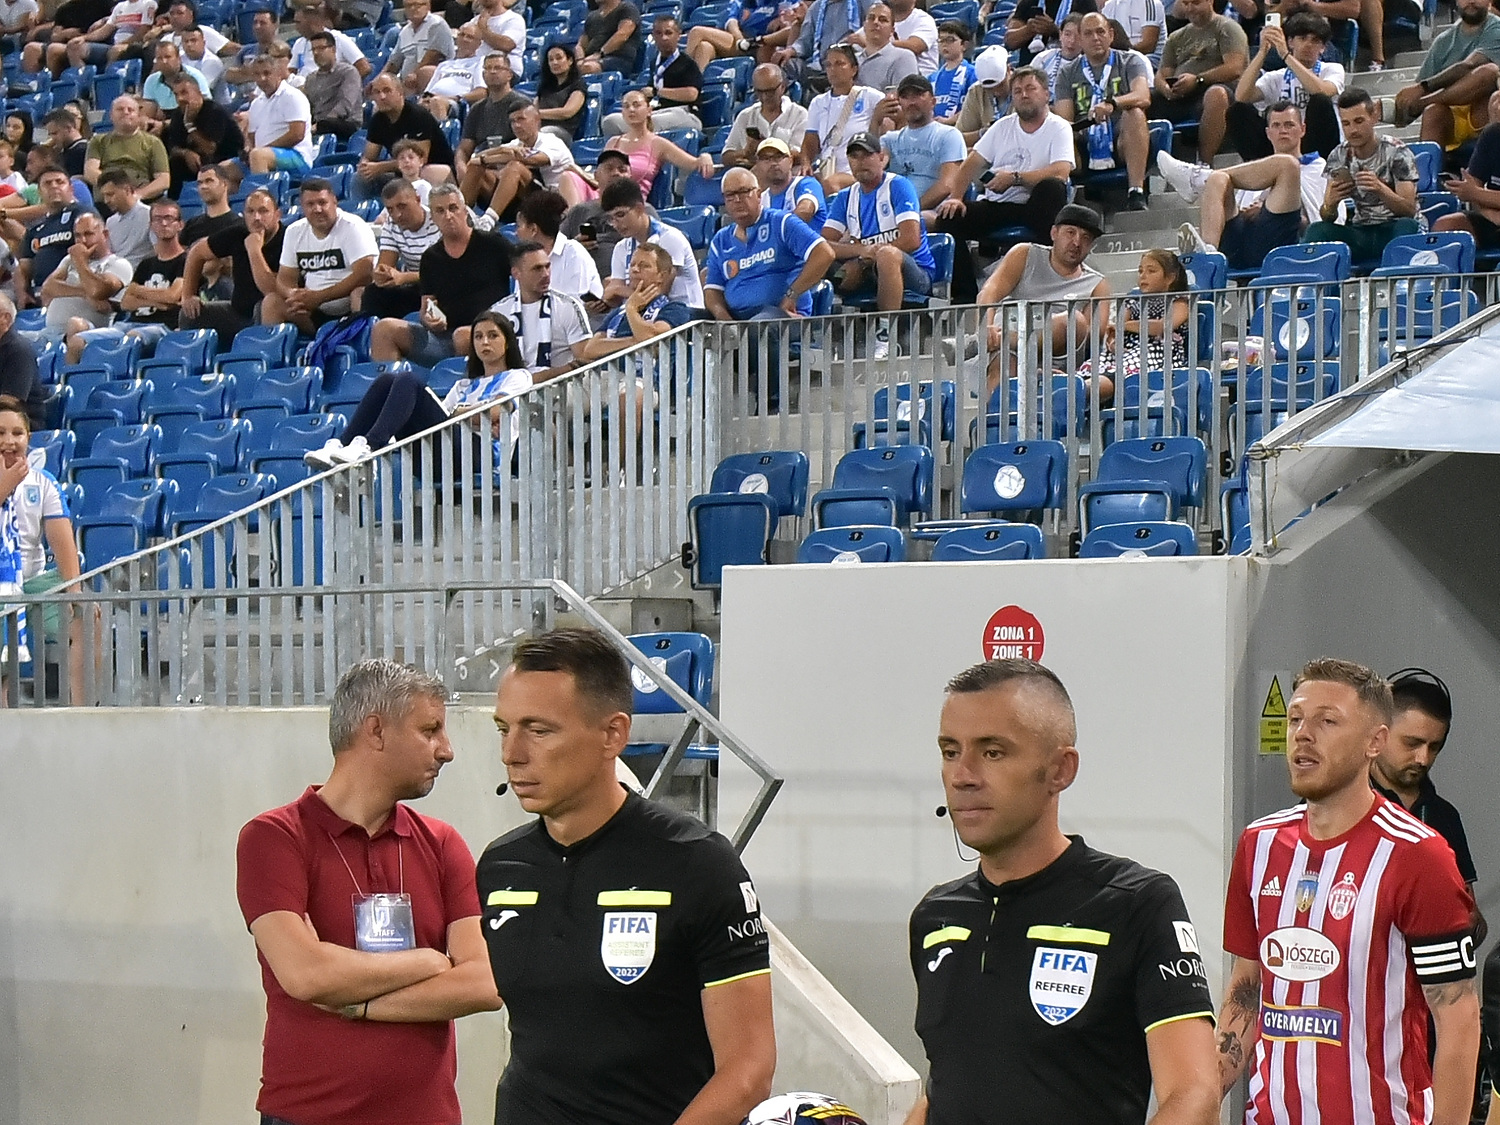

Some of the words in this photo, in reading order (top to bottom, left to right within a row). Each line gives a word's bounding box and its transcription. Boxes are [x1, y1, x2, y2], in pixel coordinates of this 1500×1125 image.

[740, 247, 775, 270] BETANO
[993, 626, 1024, 641] ZONA
[1028, 627, 1034, 640] 1
[992, 645, 1023, 660] ZONE
[1027, 645, 1033, 660] 1
[608, 917, 650, 934] FIFA
[1460, 935, 1477, 969] C
[1039, 952, 1089, 974] FIFA
[615, 967, 638, 977] 2022
[1035, 981, 1086, 996] REFEREE
[1044, 1006, 1067, 1017] 2022
[1263, 1011, 1339, 1036] GYERMELYI
